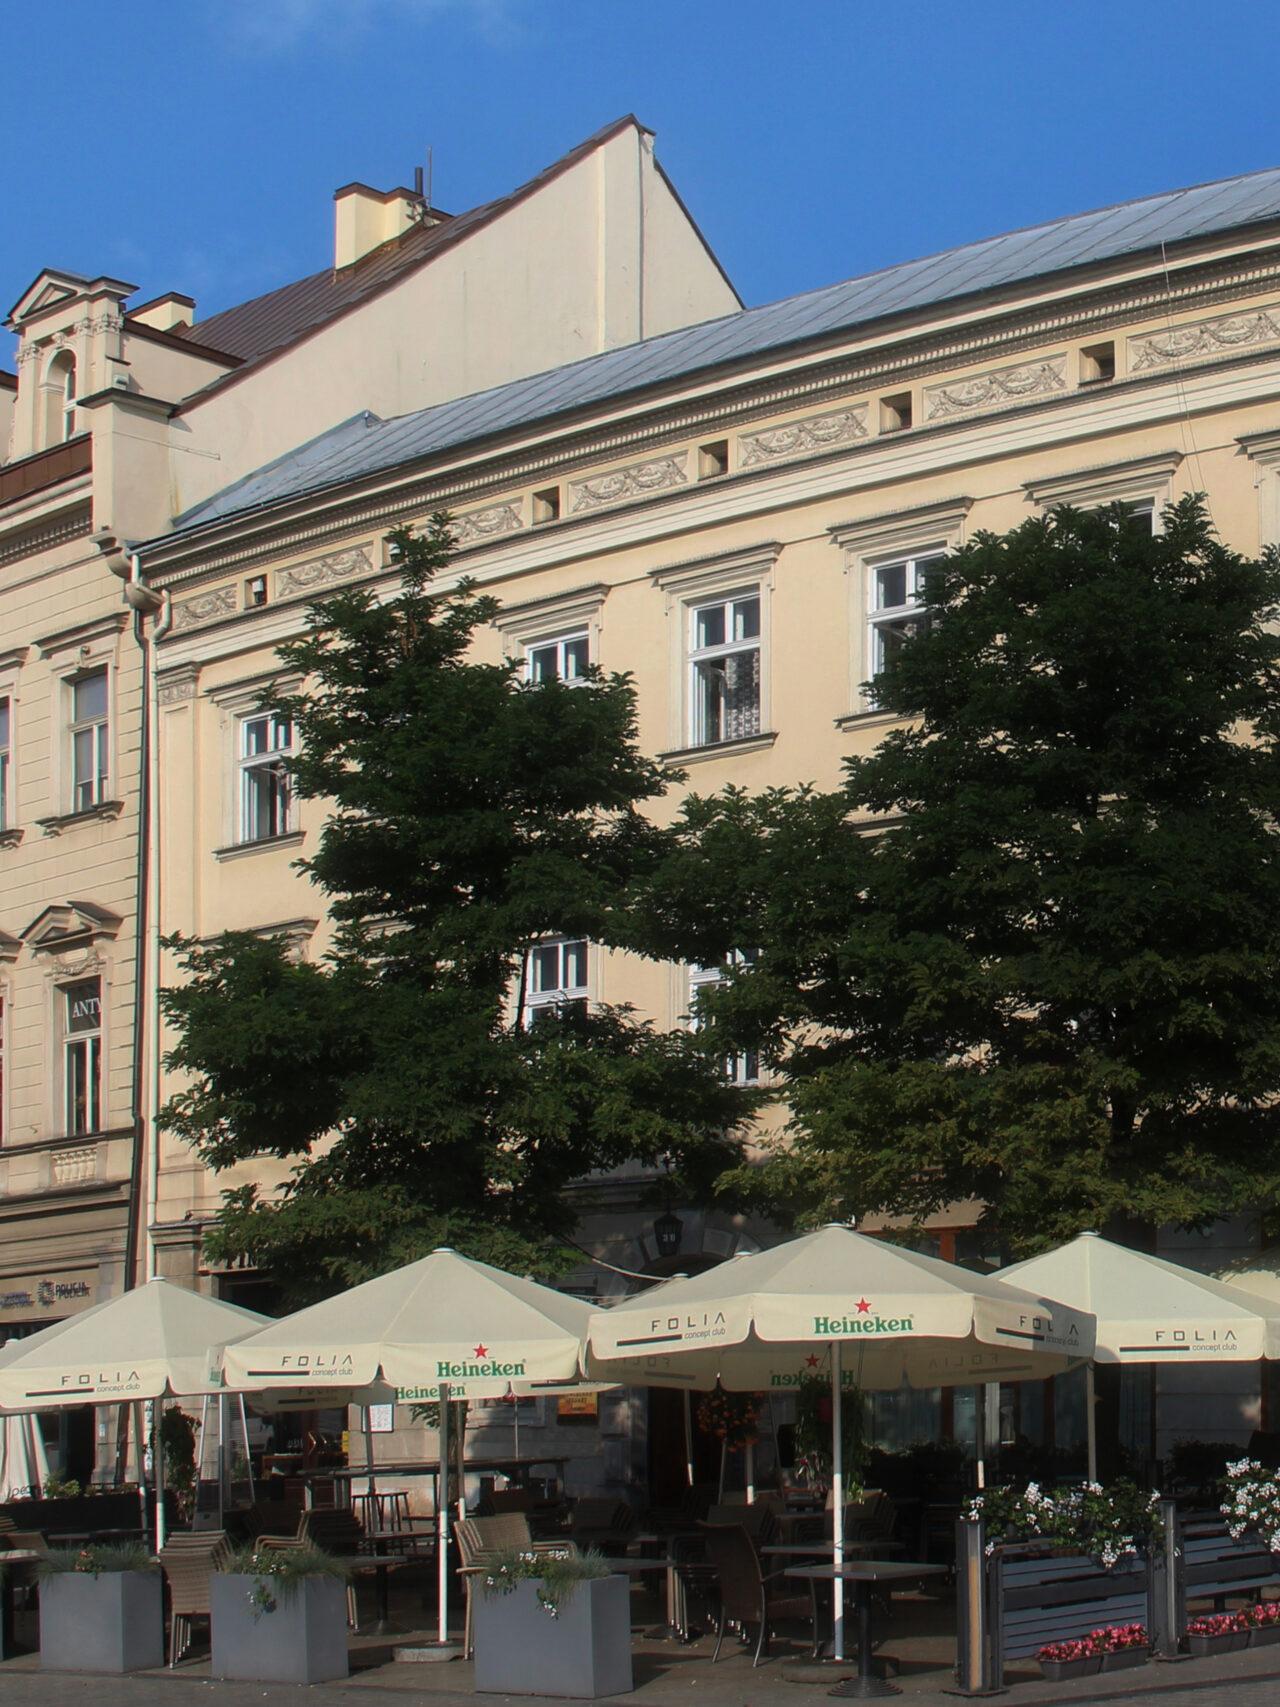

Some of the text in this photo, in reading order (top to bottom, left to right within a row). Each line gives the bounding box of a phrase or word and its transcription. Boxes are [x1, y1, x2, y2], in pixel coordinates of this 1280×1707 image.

[651, 1312, 726, 1332] FOLIA
[814, 1316, 913, 1334] Heineken
[1019, 1315, 1079, 1336] FOLA
[684, 1327, 726, 1340] concept club
[1156, 1330, 1237, 1341] FOLIA
[1222, 1342, 1237, 1350] club
[281, 1355, 353, 1366] FOLIA
[312, 1367, 353, 1377] concept club
[437, 1360, 526, 1378] Heineken
[61, 1370, 140, 1385] FOLIA
[97, 1382, 141, 1393] concept club
[395, 1383, 466, 1399] Heineen
